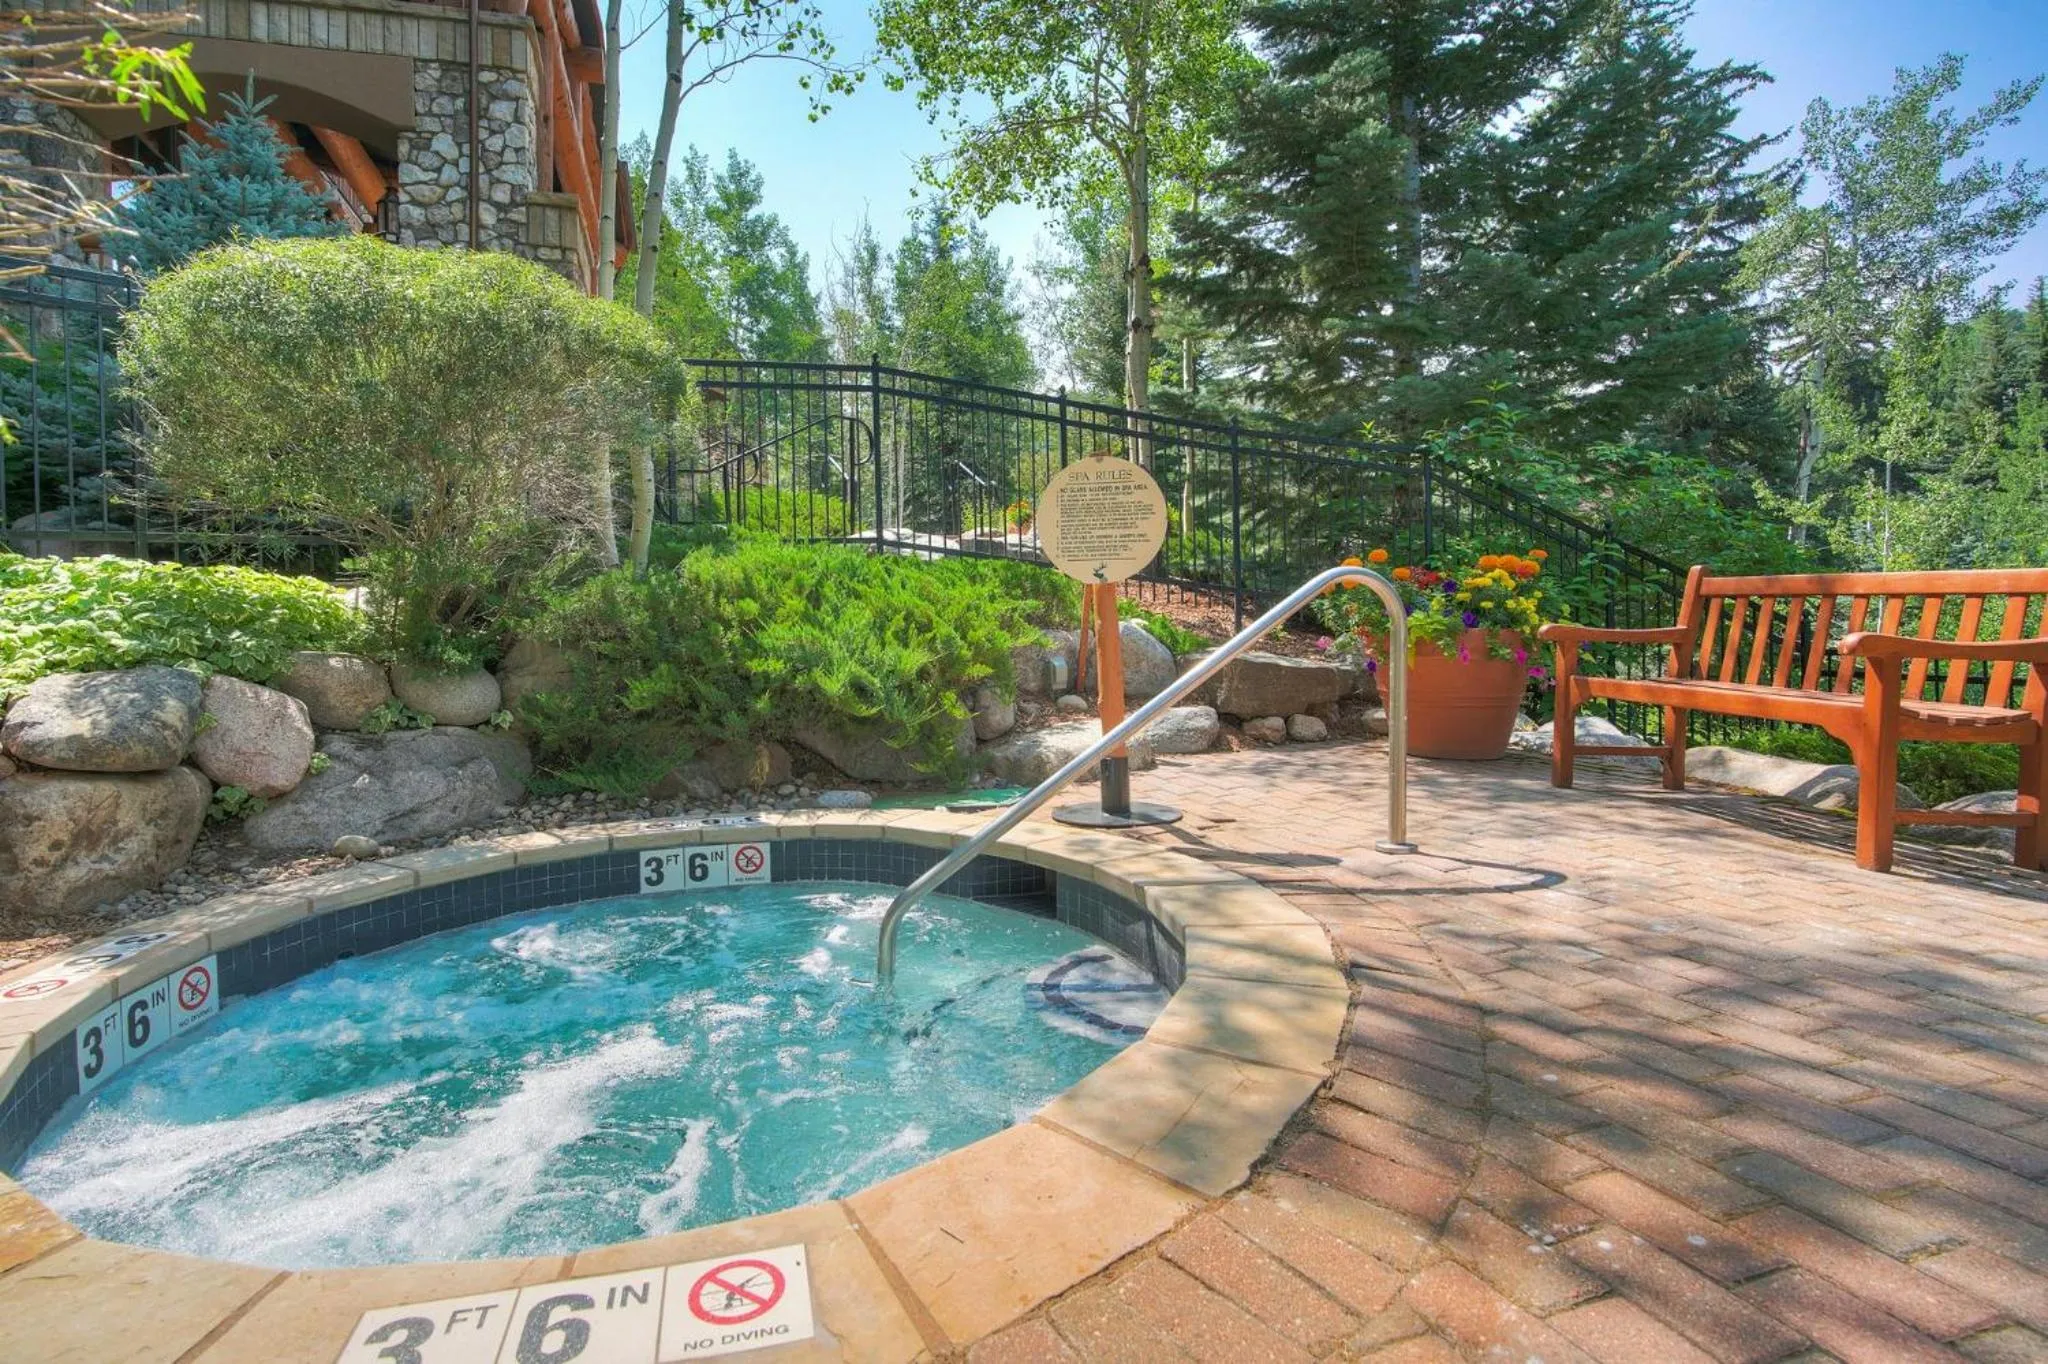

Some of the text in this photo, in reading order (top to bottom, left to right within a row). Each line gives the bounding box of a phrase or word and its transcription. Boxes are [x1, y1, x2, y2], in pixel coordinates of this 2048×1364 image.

[1068, 469, 1133, 481] SPA RULES
[644, 851, 724, 887] 3 FT 6 IN
[83, 987, 166, 1079] 3 FT 6 IN
[444, 1304, 499, 1335] FT
[516, 1293, 595, 1364] 6
[606, 1282, 650, 1310] IN
[683, 1324, 790, 1353] NO DIVING
